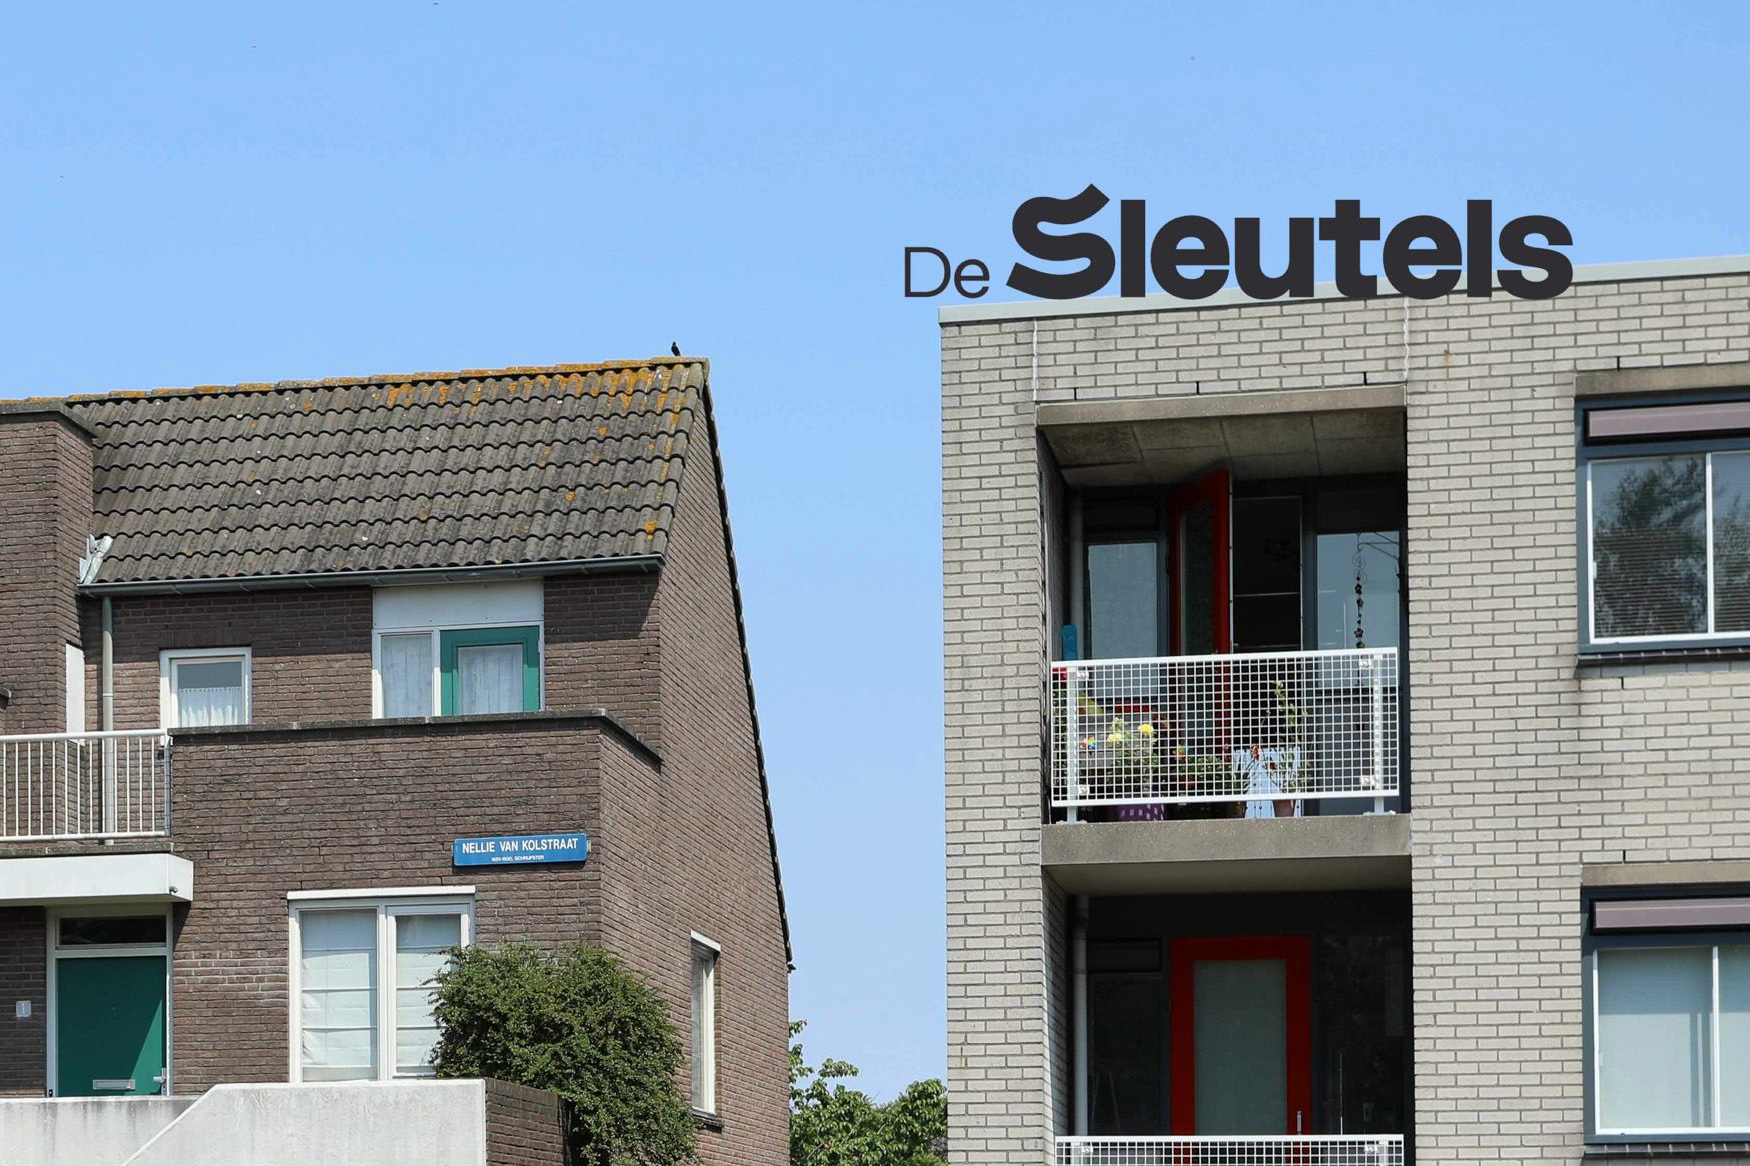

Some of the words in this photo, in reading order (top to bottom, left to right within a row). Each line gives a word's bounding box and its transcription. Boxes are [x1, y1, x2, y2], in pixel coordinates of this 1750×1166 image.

[463, 842, 495, 853] NELLIE
[500, 841, 518, 851] VAN
[522, 838, 578, 850] KOLSTRAAT
